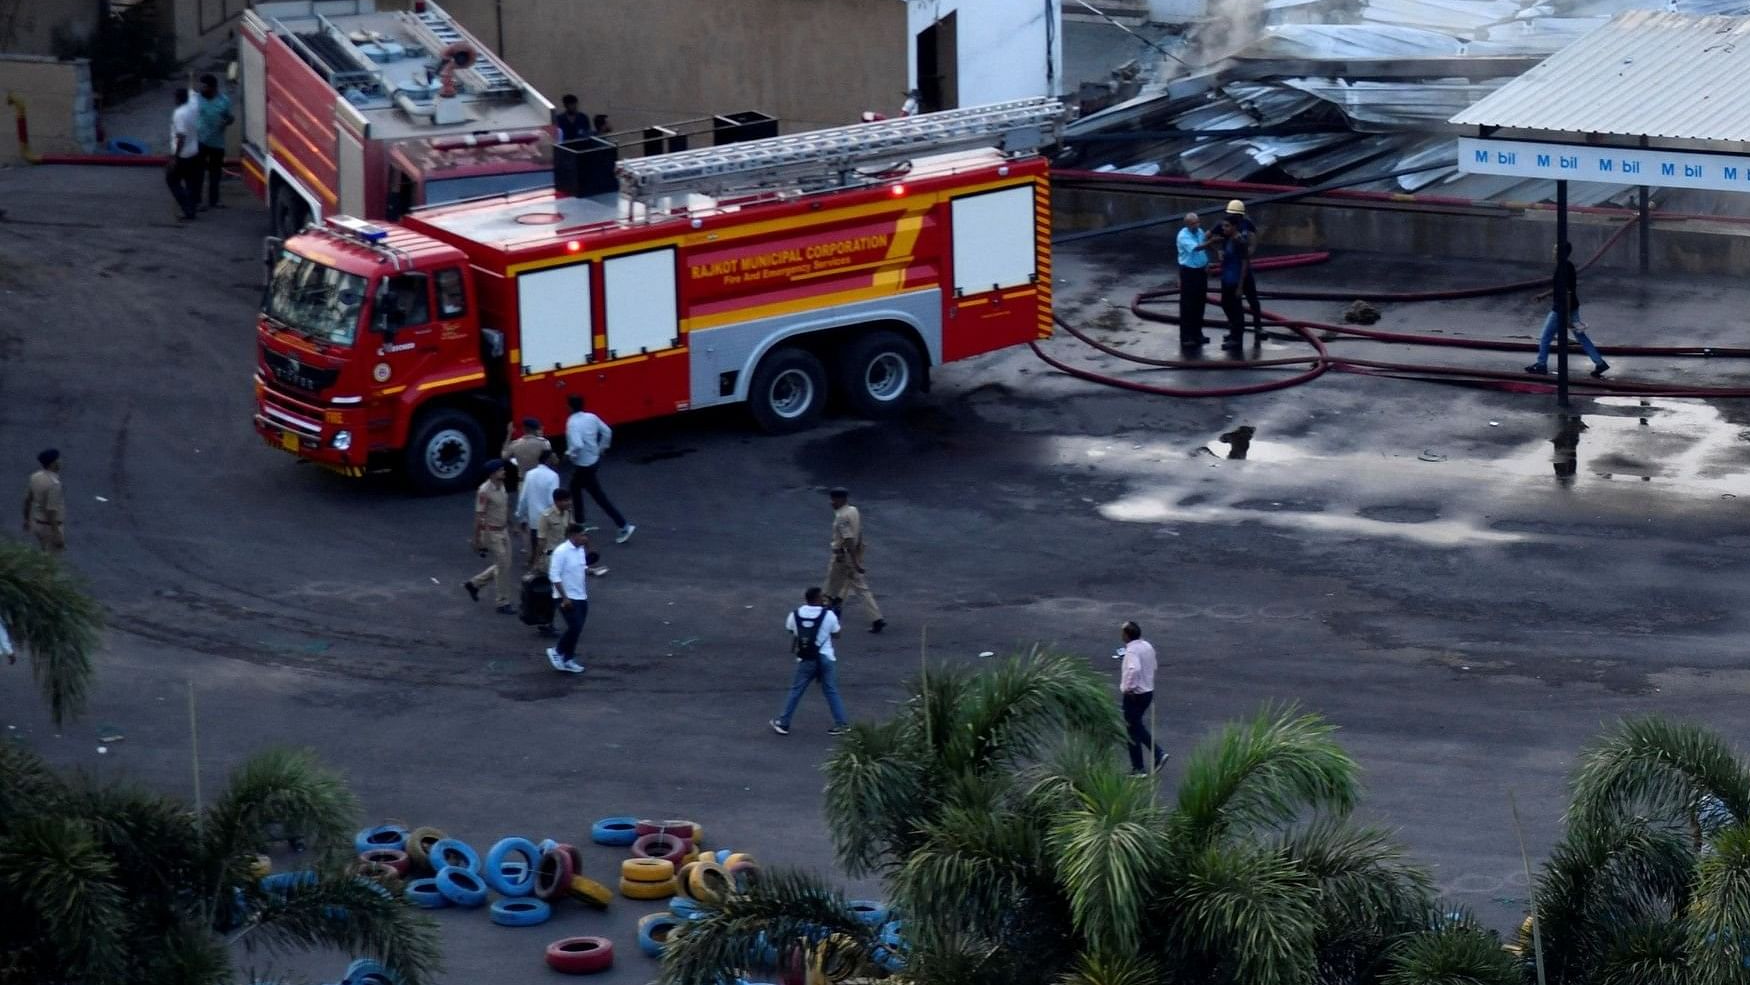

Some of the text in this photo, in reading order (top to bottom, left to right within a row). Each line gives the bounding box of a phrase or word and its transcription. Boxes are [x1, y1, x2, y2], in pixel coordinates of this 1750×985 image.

[1475, 149, 1516, 165] Mbil
[1537, 154, 1578, 169] Mbil
[1599, 158, 1640, 174] Mbil
[1661, 162, 1703, 178] Mbil
[692, 235, 886, 279] RAJKOT MUNICIPAL CORPORATION
[724, 256, 851, 285] Fire And Emergency Services
